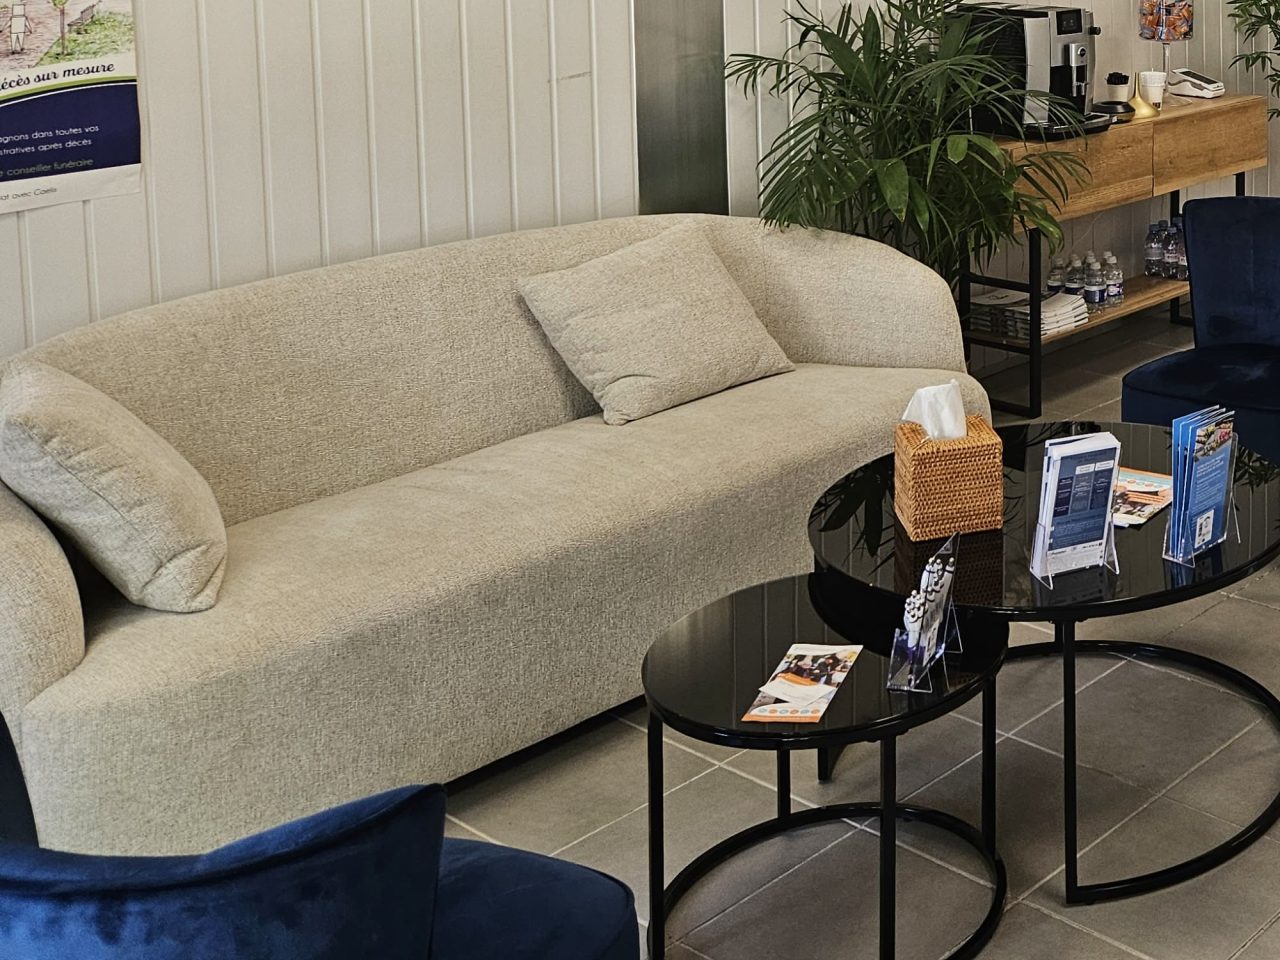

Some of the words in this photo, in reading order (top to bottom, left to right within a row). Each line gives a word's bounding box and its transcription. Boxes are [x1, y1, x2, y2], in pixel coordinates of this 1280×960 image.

[34, 71, 58, 83] sur
[63, 63, 115, 78] mesure
[32, 130, 53, 139] dans
[56, 127, 82, 136] toutes
[38, 142, 62, 152] après
[65, 139, 92, 148] décès
[7, 164, 51, 176] conseiller
[54, 158, 94, 170] funéraire
